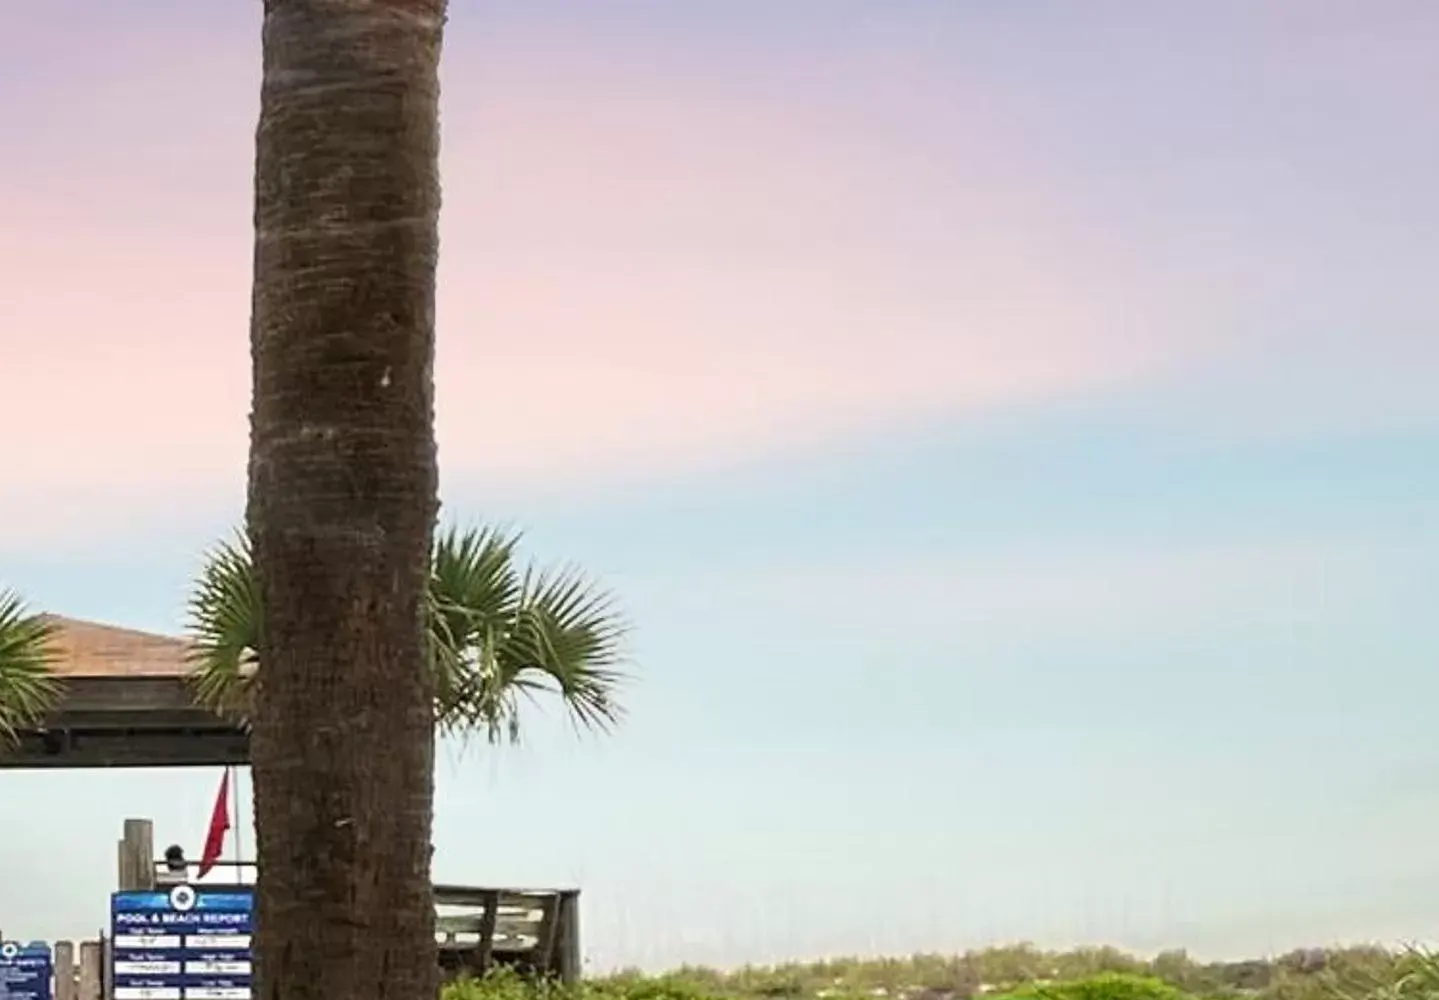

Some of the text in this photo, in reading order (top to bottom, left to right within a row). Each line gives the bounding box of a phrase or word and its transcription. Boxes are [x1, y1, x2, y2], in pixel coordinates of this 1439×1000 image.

[116, 913, 150, 924] POOL
[162, 913, 201, 924] BEACH
[203, 913, 249, 924] REPORT
